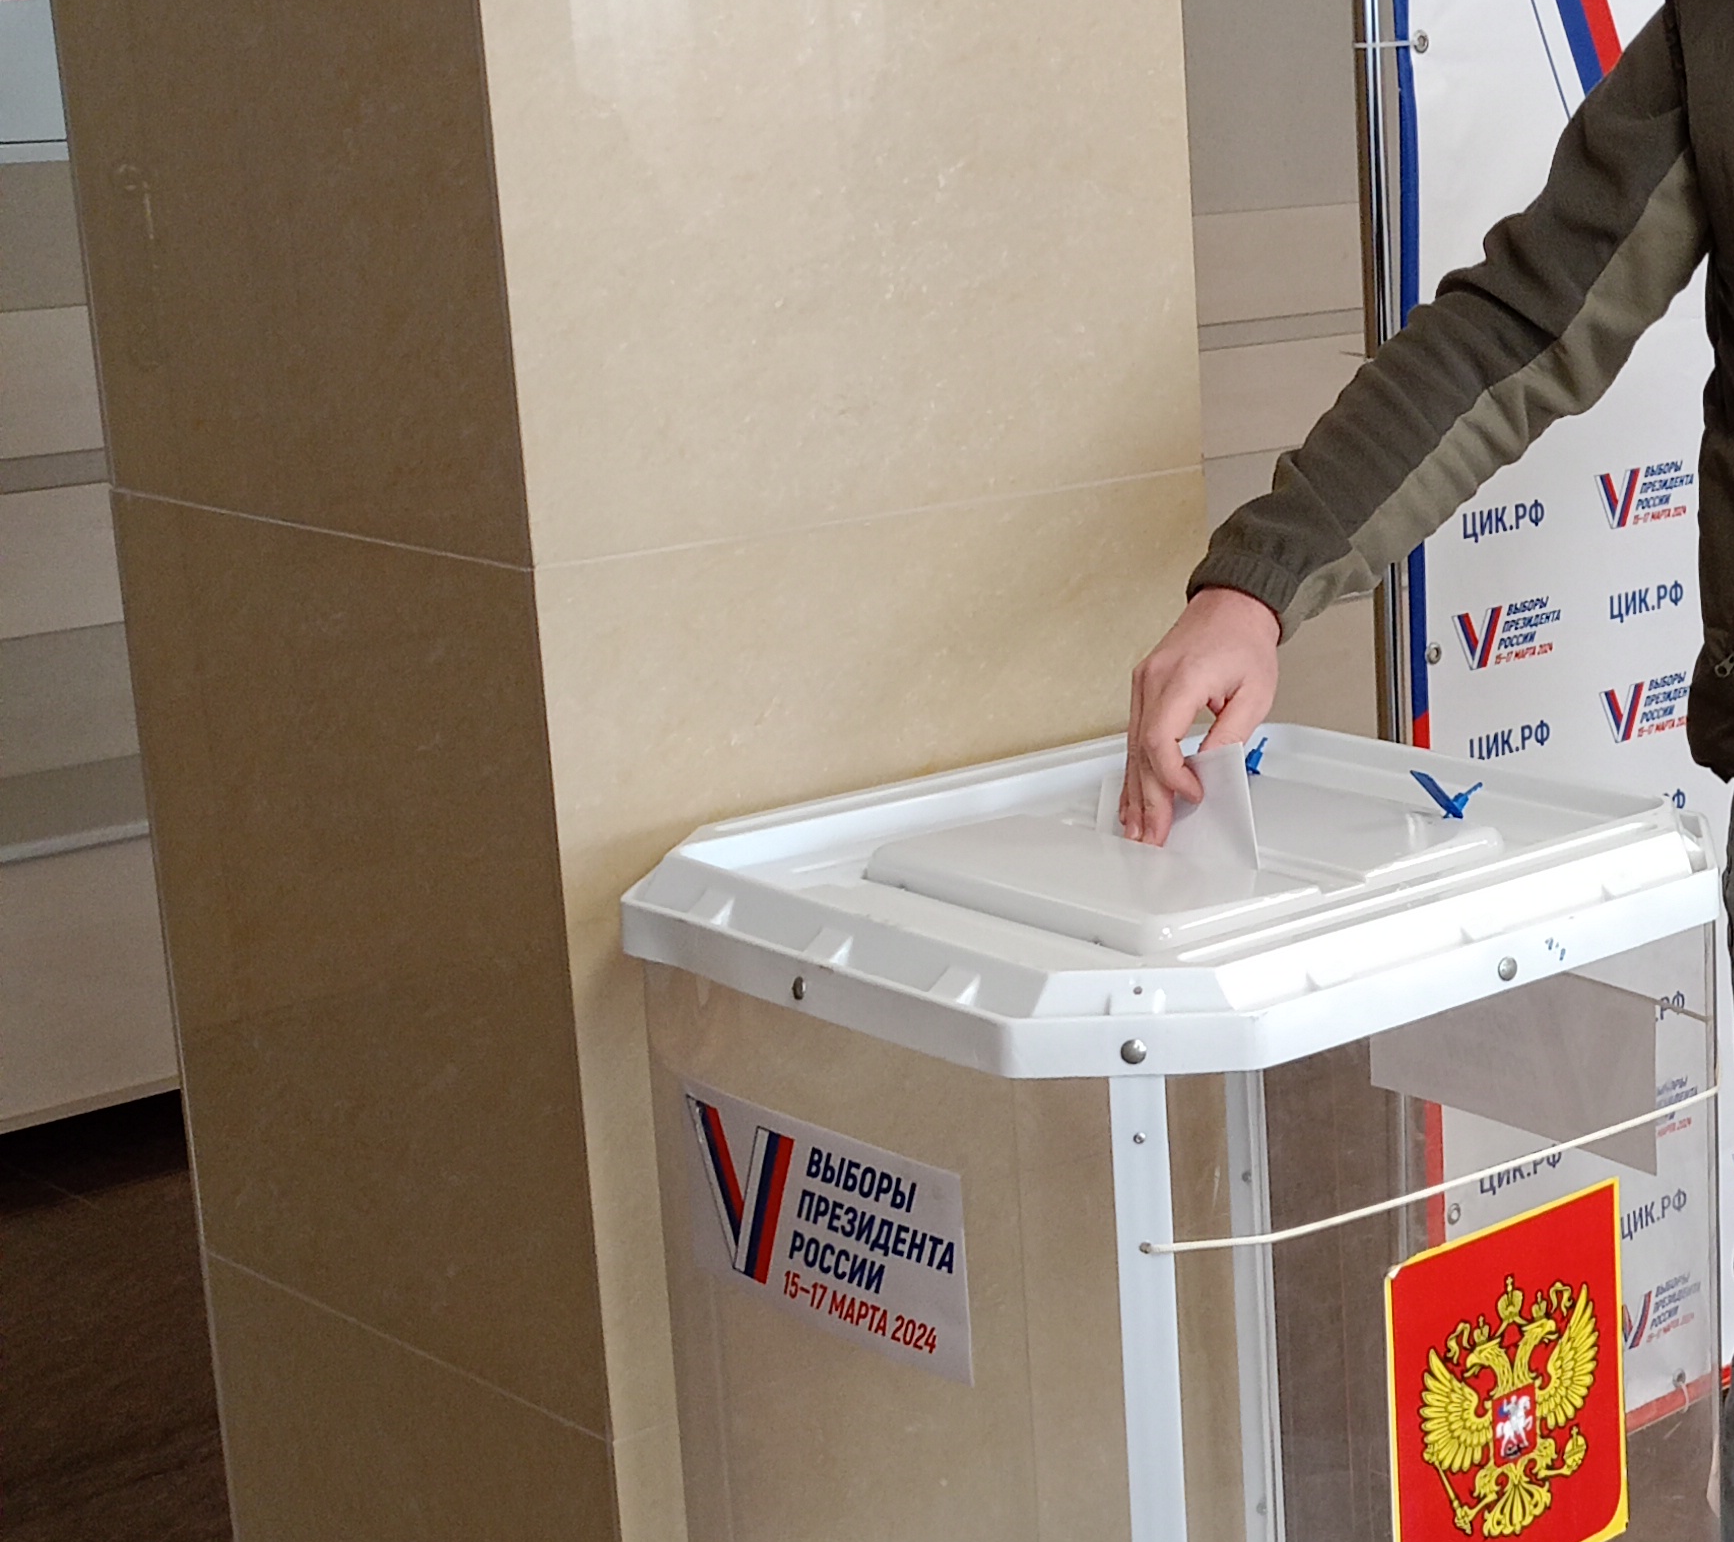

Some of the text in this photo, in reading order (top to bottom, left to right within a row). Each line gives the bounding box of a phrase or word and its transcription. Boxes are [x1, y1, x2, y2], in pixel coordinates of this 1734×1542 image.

[1644, 459, 1683, 478] ВЫБОРЫ
[1639, 473, 1694, 494] ПРЕЗИДЕНТА
[1635, 493, 1672, 511] РОССИИ
[1462, 499, 1545, 543] ЦИК.РФ
[1506, 595, 1549, 616] ВЫБОРЫ
[1610, 580, 1683, 623] ЦИК.РФ
[1502, 609, 1561, 634] ПРЕЗИДЕНТА
[1497, 631, 1537, 650] РОССИИ
[1648, 670, 1687, 691] ВЫБОРЫ
[1644, 685, 1690, 707] ПРЕЗИДЕН
[1640, 705, 1675, 724] РОССИИ
[1469, 719, 1550, 760] ЦИК.РФ
[806, 1146, 917, 1213] ВЫБОРЫ
[1620, 1188, 1687, 1240] ЦИК.РФ
[797, 1189, 956, 1274] ПРЕЗИДЕНТА
[789, 1230, 886, 1294] РОССИИ
[828, 1289, 889, 1337] МАРТА
[890, 1314, 938, 1354] 2024
